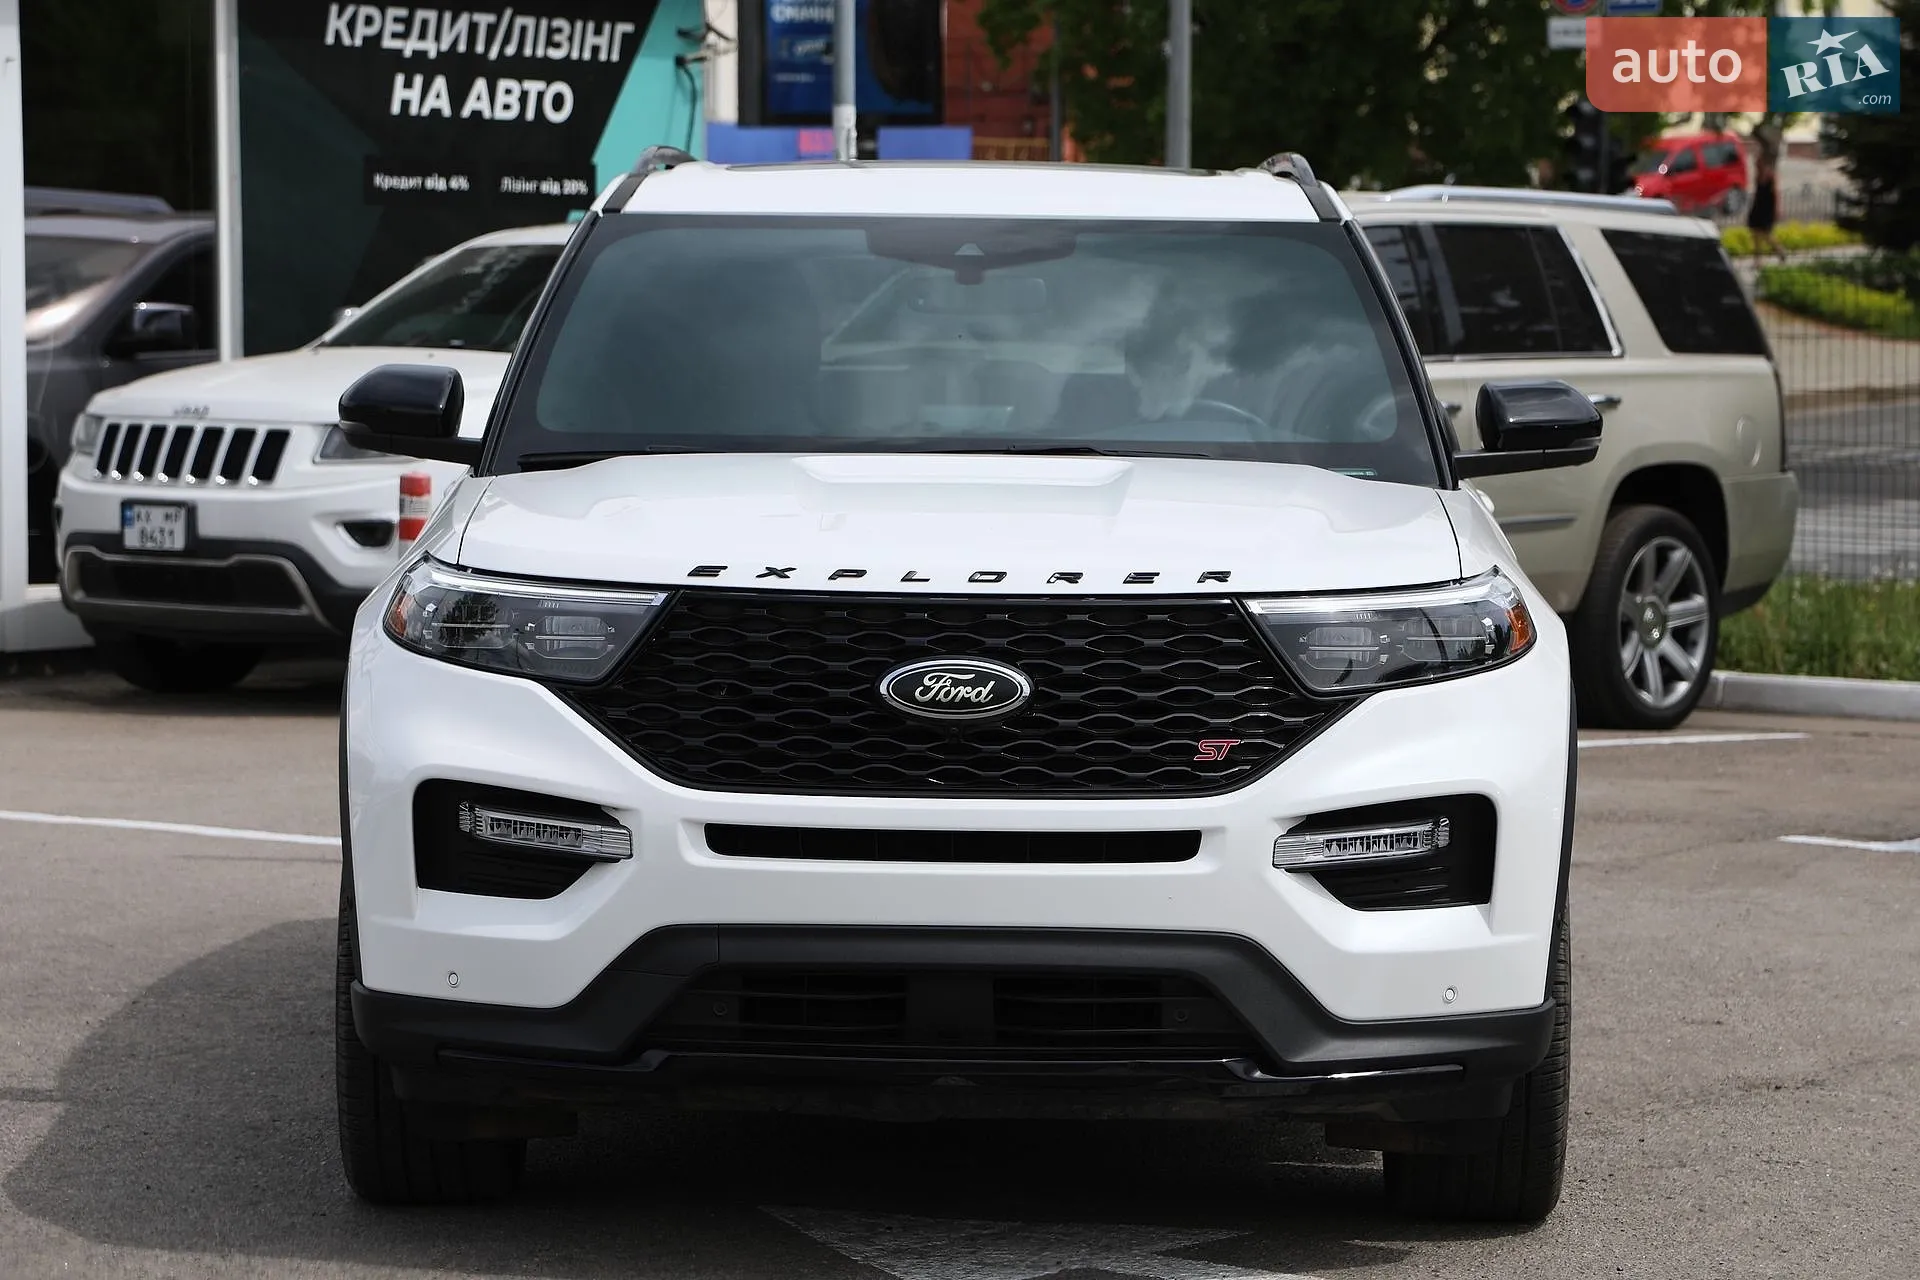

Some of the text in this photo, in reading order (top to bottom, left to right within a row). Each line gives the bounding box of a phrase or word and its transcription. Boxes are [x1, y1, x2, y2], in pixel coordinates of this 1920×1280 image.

[324, 2, 635, 62] КРЕДИТ/ЛІЗІНГ
[390, 72, 574, 124] НА АВТО
[373, 172, 423, 191] Кредит
[687, 565, 1232, 584] EXPLORER
[914, 672, 996, 703] Ford
[1193, 739, 1241, 761] ST
